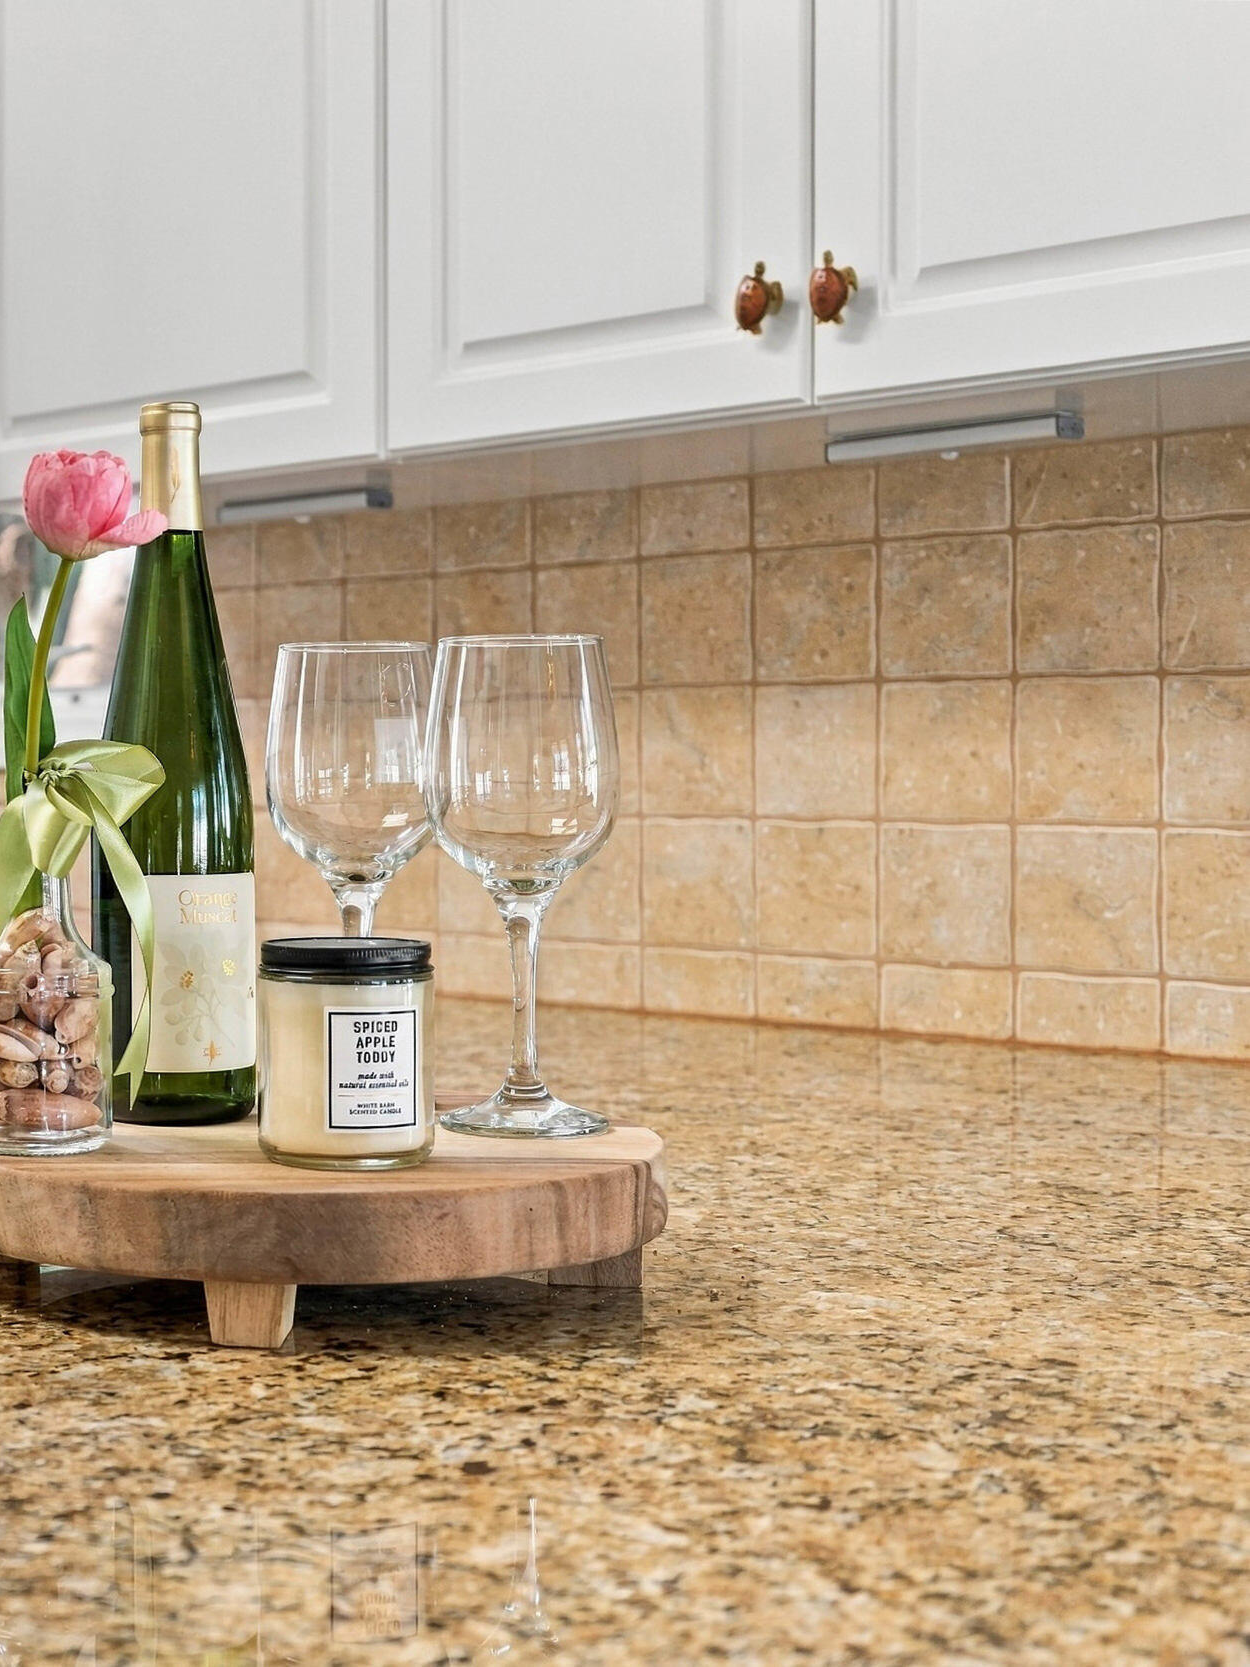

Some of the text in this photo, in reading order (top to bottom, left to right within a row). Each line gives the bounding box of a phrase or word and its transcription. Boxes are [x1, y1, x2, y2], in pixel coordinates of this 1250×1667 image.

[353, 1020, 398, 1033] SPICED
[356, 1035, 395, 1048] APPLE
[356, 1050, 395, 1064] TODDY
[357, 1071, 377, 1080] made
[339, 1080, 366, 1089] natural
